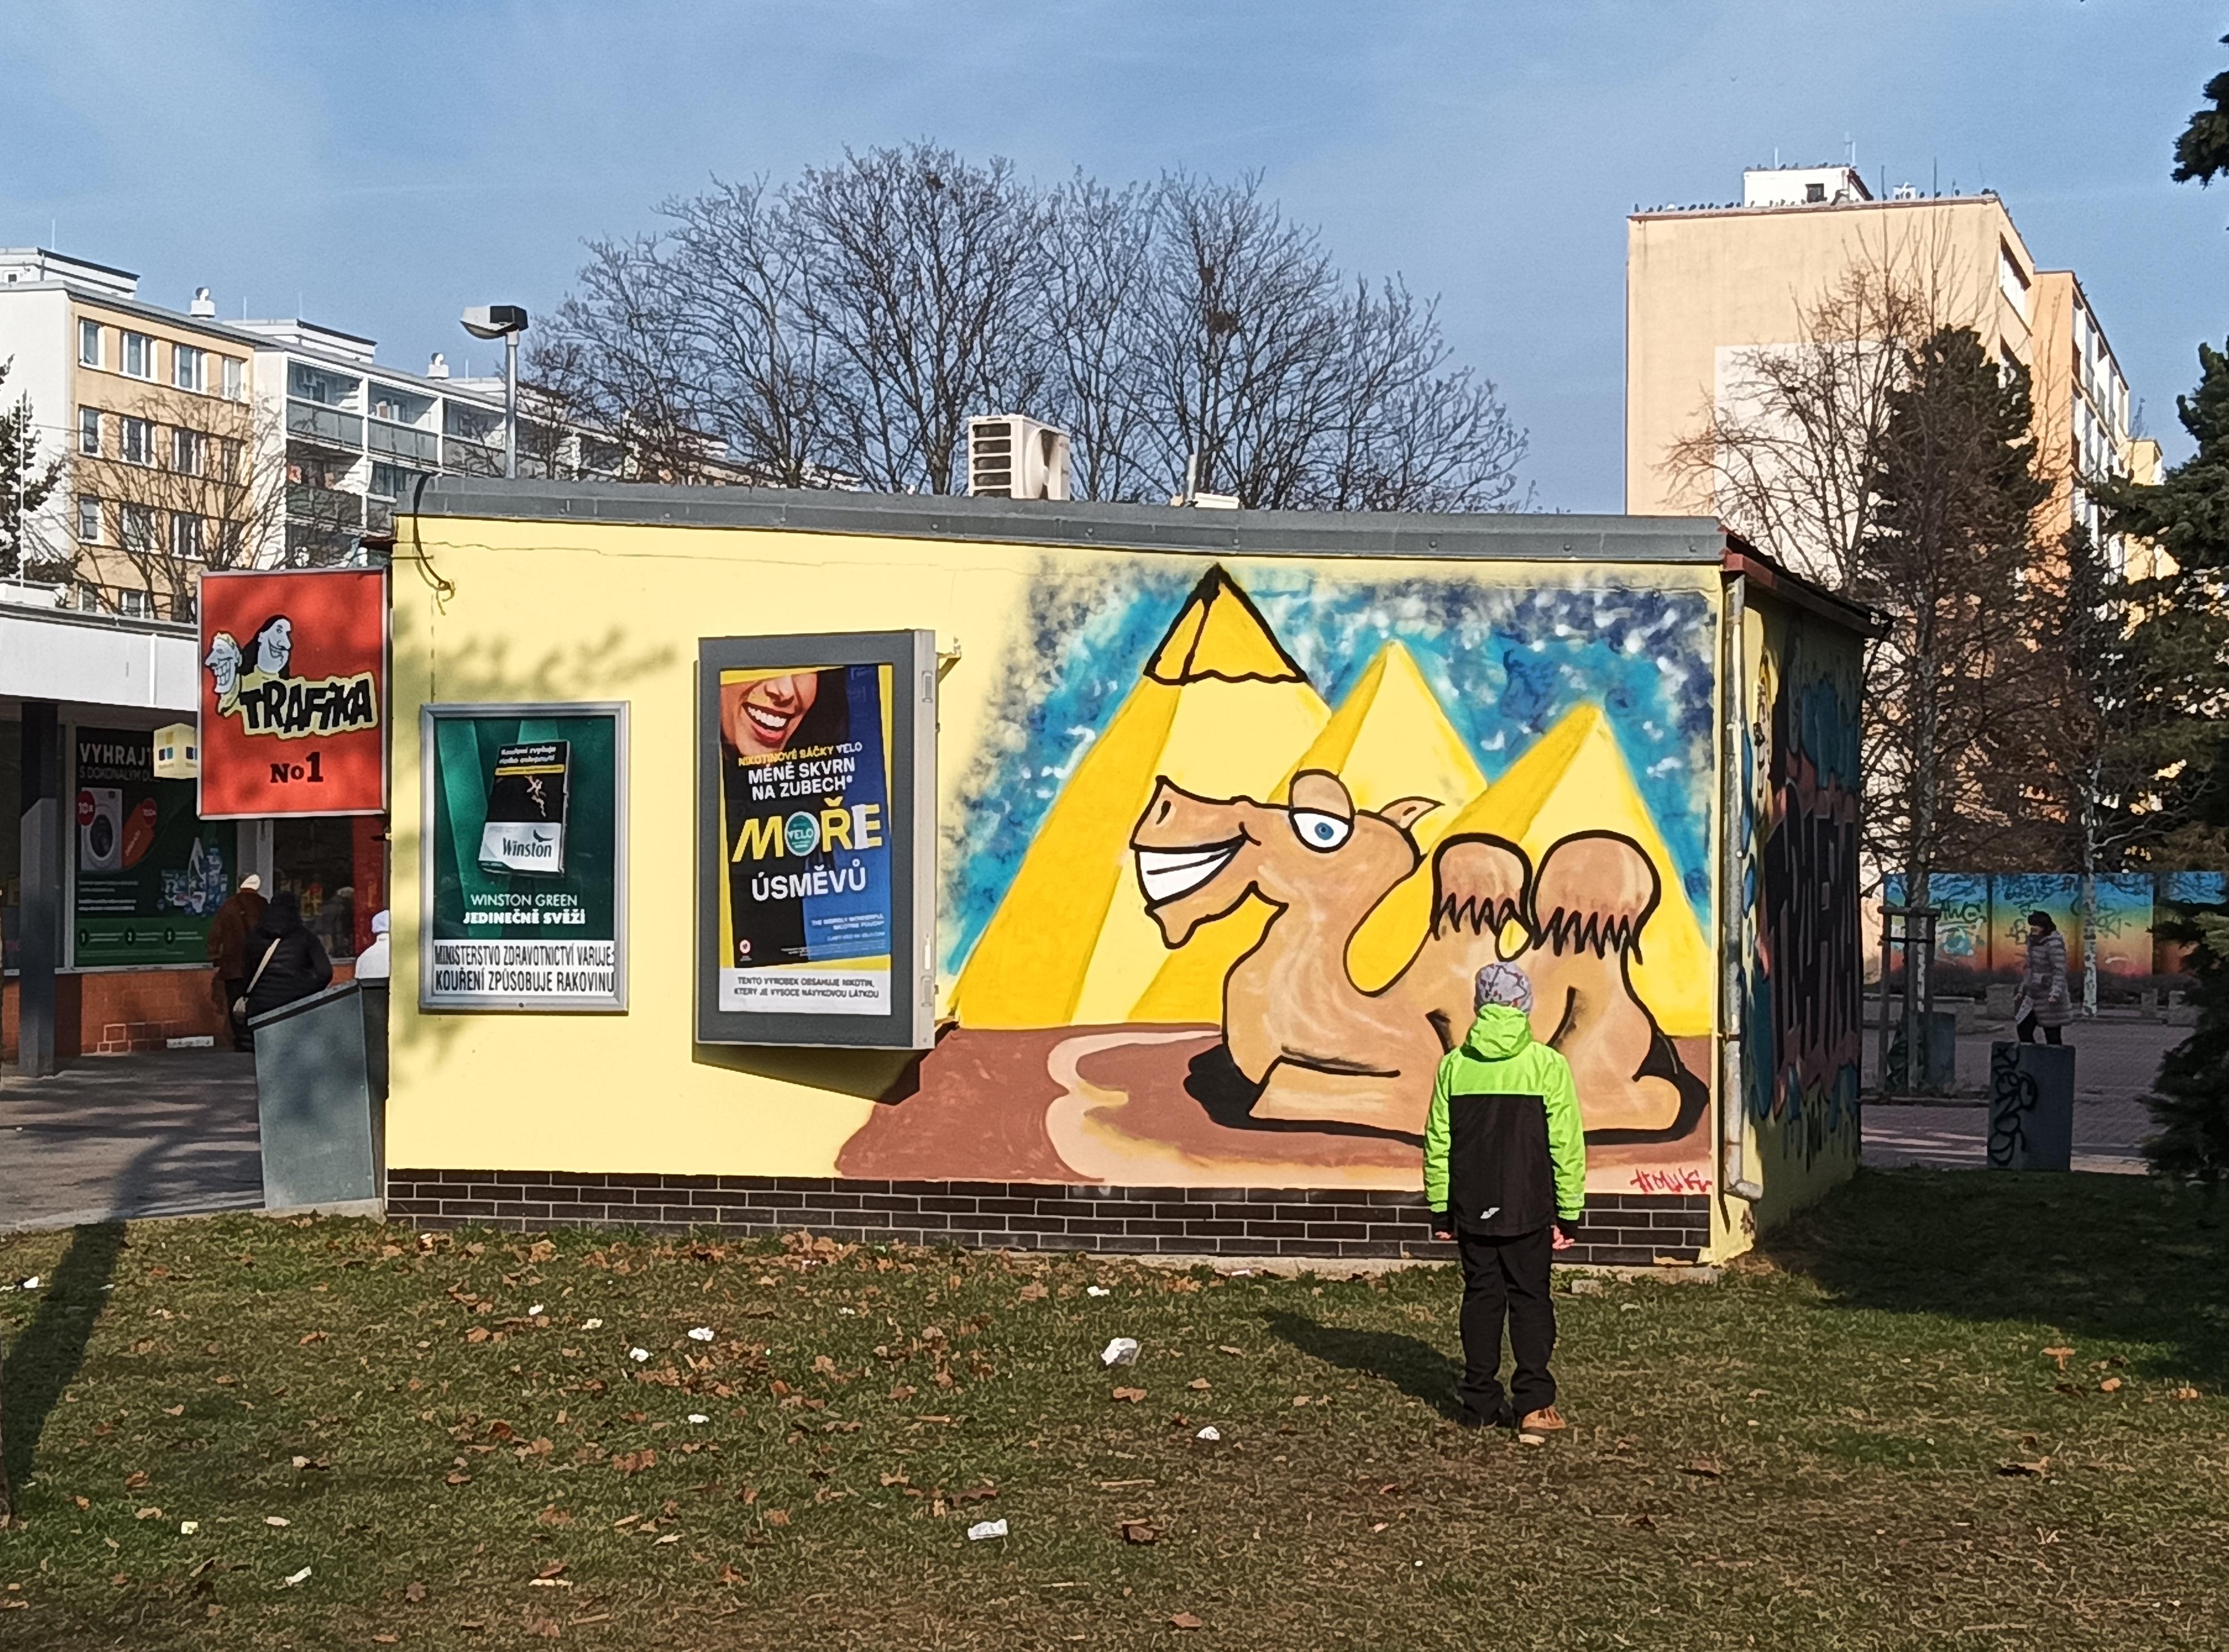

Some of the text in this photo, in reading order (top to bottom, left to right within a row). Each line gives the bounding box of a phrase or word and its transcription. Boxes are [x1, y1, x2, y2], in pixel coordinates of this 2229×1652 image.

[836, 742, 863, 754] VELO
[748, 757, 855, 784] MÉNĚ SKVRN
[753, 784, 776, 801] NA
[787, 828, 814, 841] VELO
[503, 837, 552, 857] Winston
[752, 859, 866, 901] ÚSMĚVŮ
[470, 894, 577, 907] WINSTON GREEN
[543, 909, 586, 924] SVĚŽÍ
[436, 967, 485, 991] KOUŘENÍ
[557, 971, 614, 992] RAKOVINU
